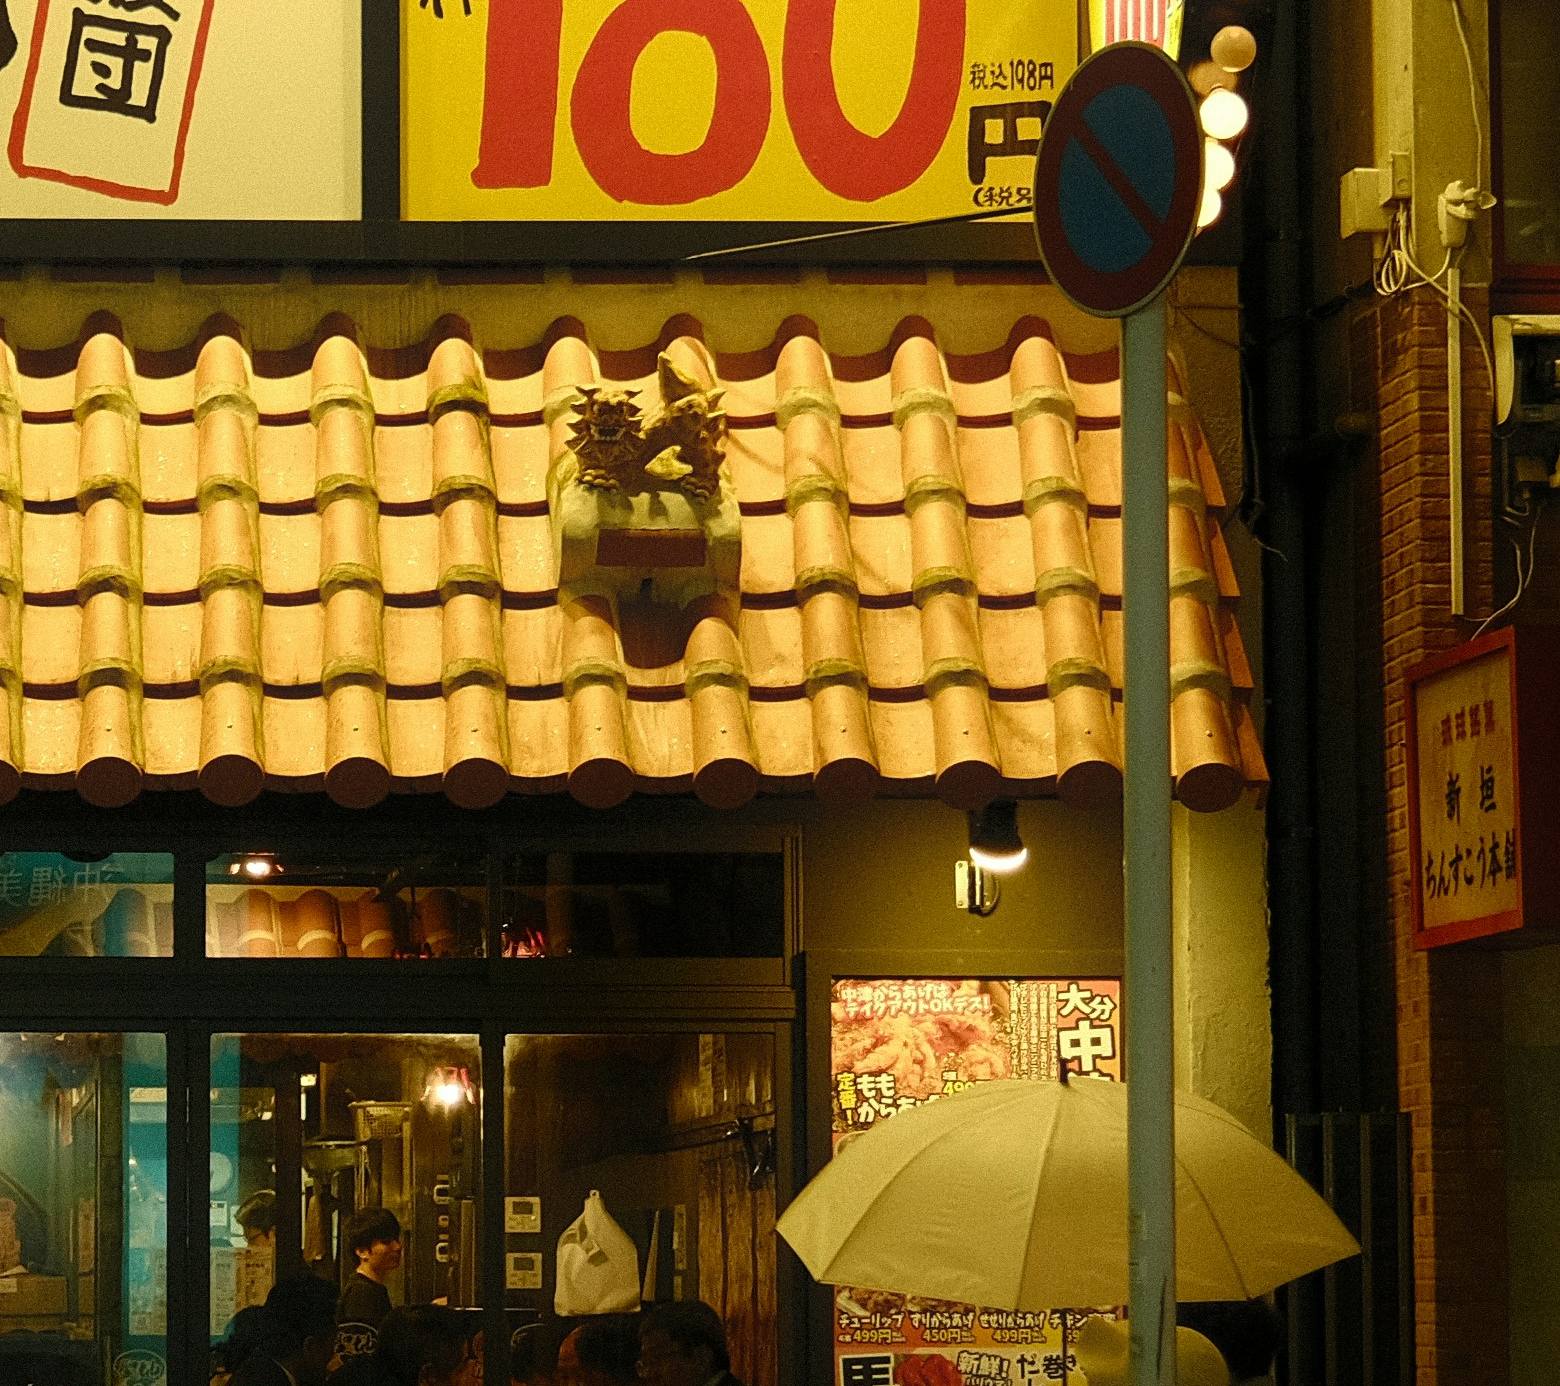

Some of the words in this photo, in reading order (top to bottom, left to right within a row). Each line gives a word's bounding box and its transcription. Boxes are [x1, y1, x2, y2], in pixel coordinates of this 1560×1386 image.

[968, 58, 1055, 92] 税込198円
[1057, 982, 1117, 1021] 大分
[1057, 1017, 1116, 1081] 中
[856, 1072, 896, 1098] もも
